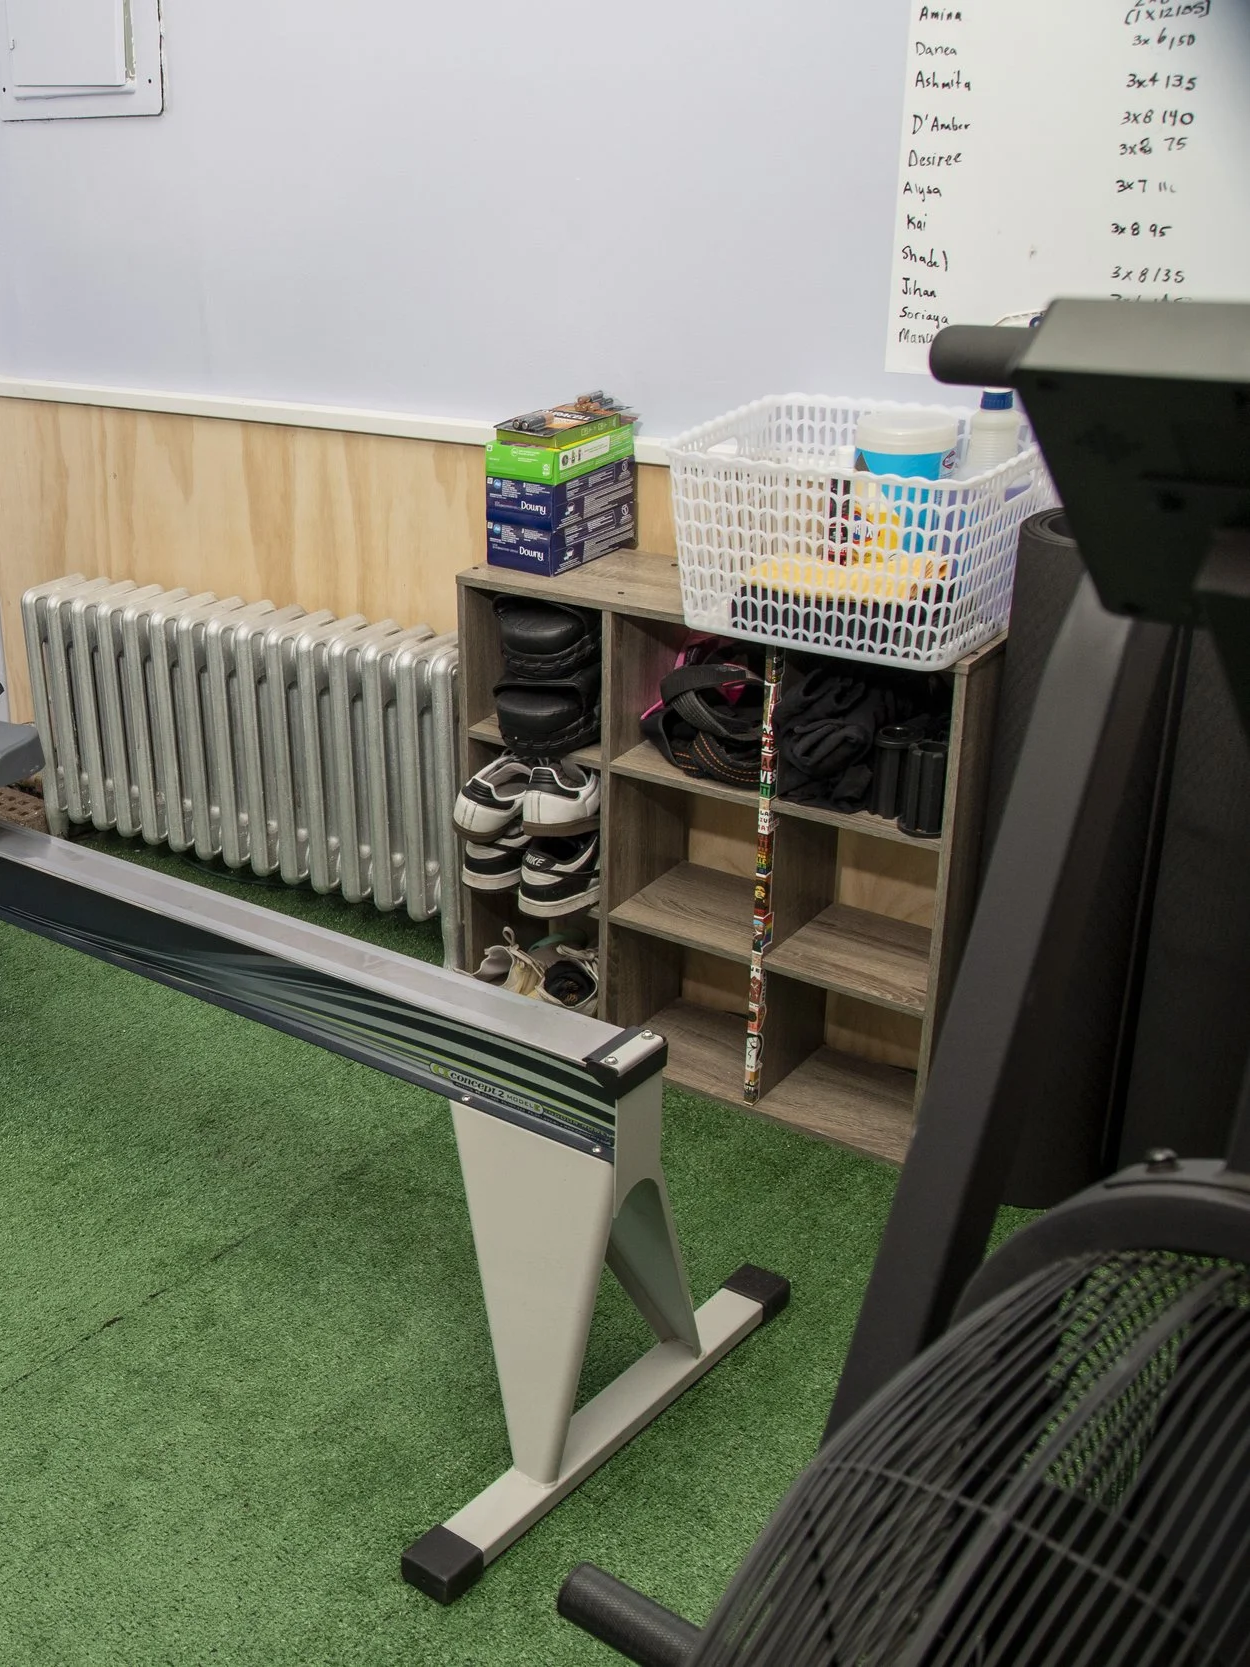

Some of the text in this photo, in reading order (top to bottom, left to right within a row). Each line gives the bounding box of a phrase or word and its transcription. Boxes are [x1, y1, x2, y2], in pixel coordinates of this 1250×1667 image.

[918, 5, 963, 22] Amina
[1161, 109, 1195, 127] 140
[908, 149, 963, 168] Desiree
[906, 213, 928, 232] Kai
[1149, 222, 1173, 238] 95
[520, 500, 548, 516] Downy
[519, 546, 545, 562] Downy
[506, 1094, 534, 1109] MODEL
